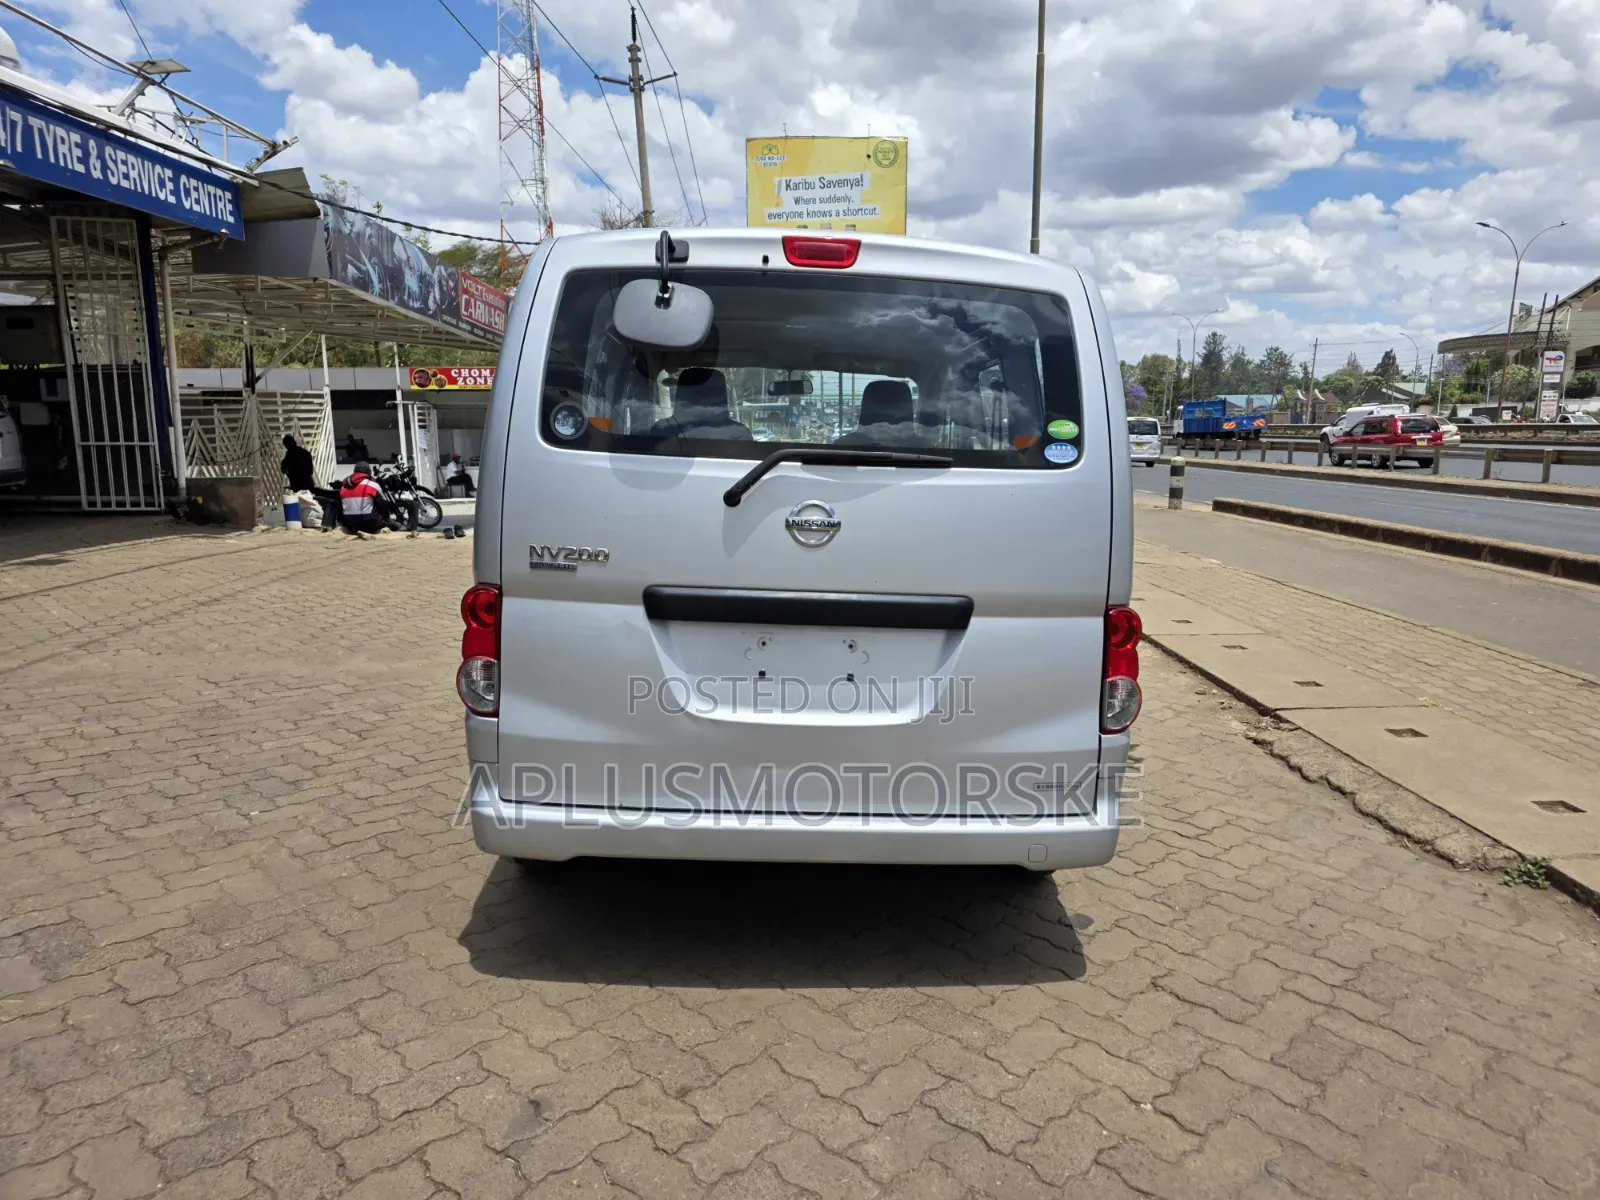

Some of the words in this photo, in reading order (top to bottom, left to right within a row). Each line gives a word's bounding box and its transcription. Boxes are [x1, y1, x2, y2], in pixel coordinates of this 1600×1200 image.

[28, 115, 85, 174] TYRE
[89, 138, 103, 180] &
[104, 145, 176, 204] SERVICE
[180, 174, 235, 224] CENTRE
[785, 177, 815, 191] Karibu
[819, 173, 864, 190] Savenya!
[794, 195, 817, 206] Where
[768, 210, 804, 222] everyone
[806, 207, 832, 218] knows
[835, 209, 840, 217] a
[843, 207, 879, 217] shortcut.
[462, 294, 505, 331] CARWASH
[457, 377, 494, 385] ZONE
[791, 518, 836, 529] NISSAN
[529, 543, 609, 563] NV200
